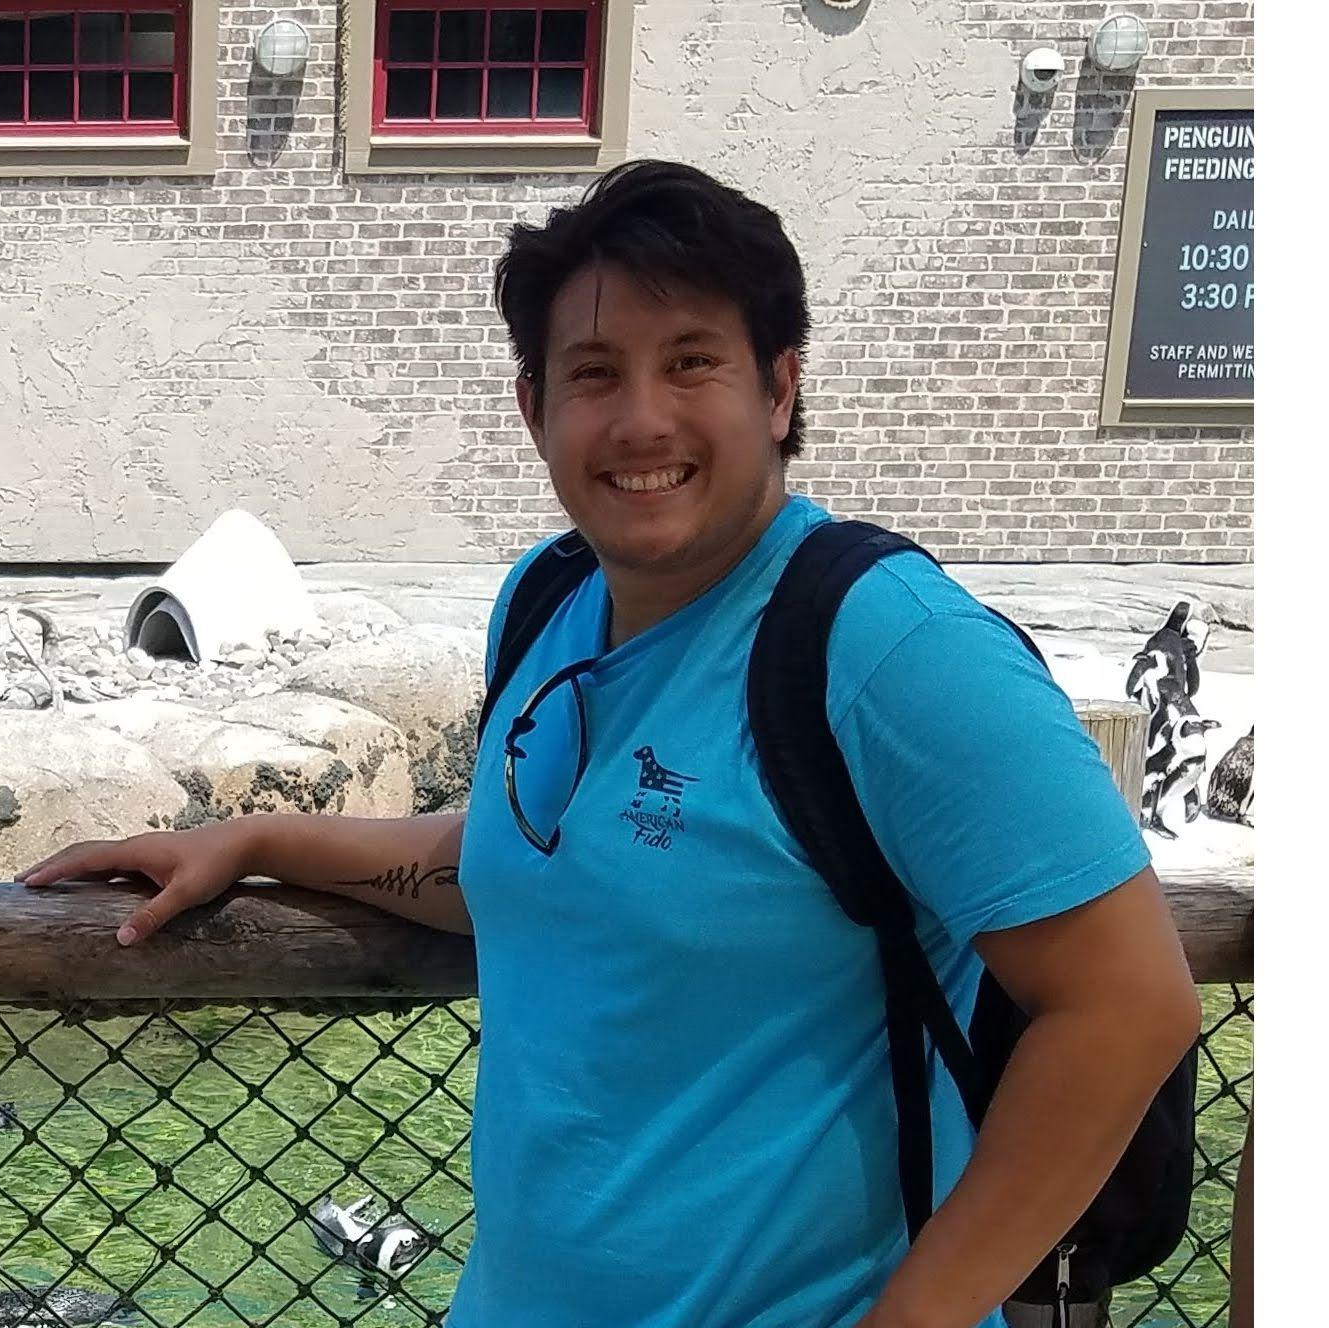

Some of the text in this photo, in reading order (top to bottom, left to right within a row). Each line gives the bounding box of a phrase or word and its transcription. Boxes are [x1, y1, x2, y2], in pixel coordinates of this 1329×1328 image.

[1163, 125, 1254, 149] PENGUIN
[1164, 156, 1254, 180] FEEDING
[1212, 209, 1254, 230] DAIL
[1179, 244, 1249, 271] 10:30
[1181, 283, 1237, 310] 3:30
[1150, 344, 1254, 360] STAFF AND WE
[1178, 363, 1254, 379] PERMITTIN
[618, 809, 685, 833] AMERICAN
[632, 827, 672, 850] Fido
